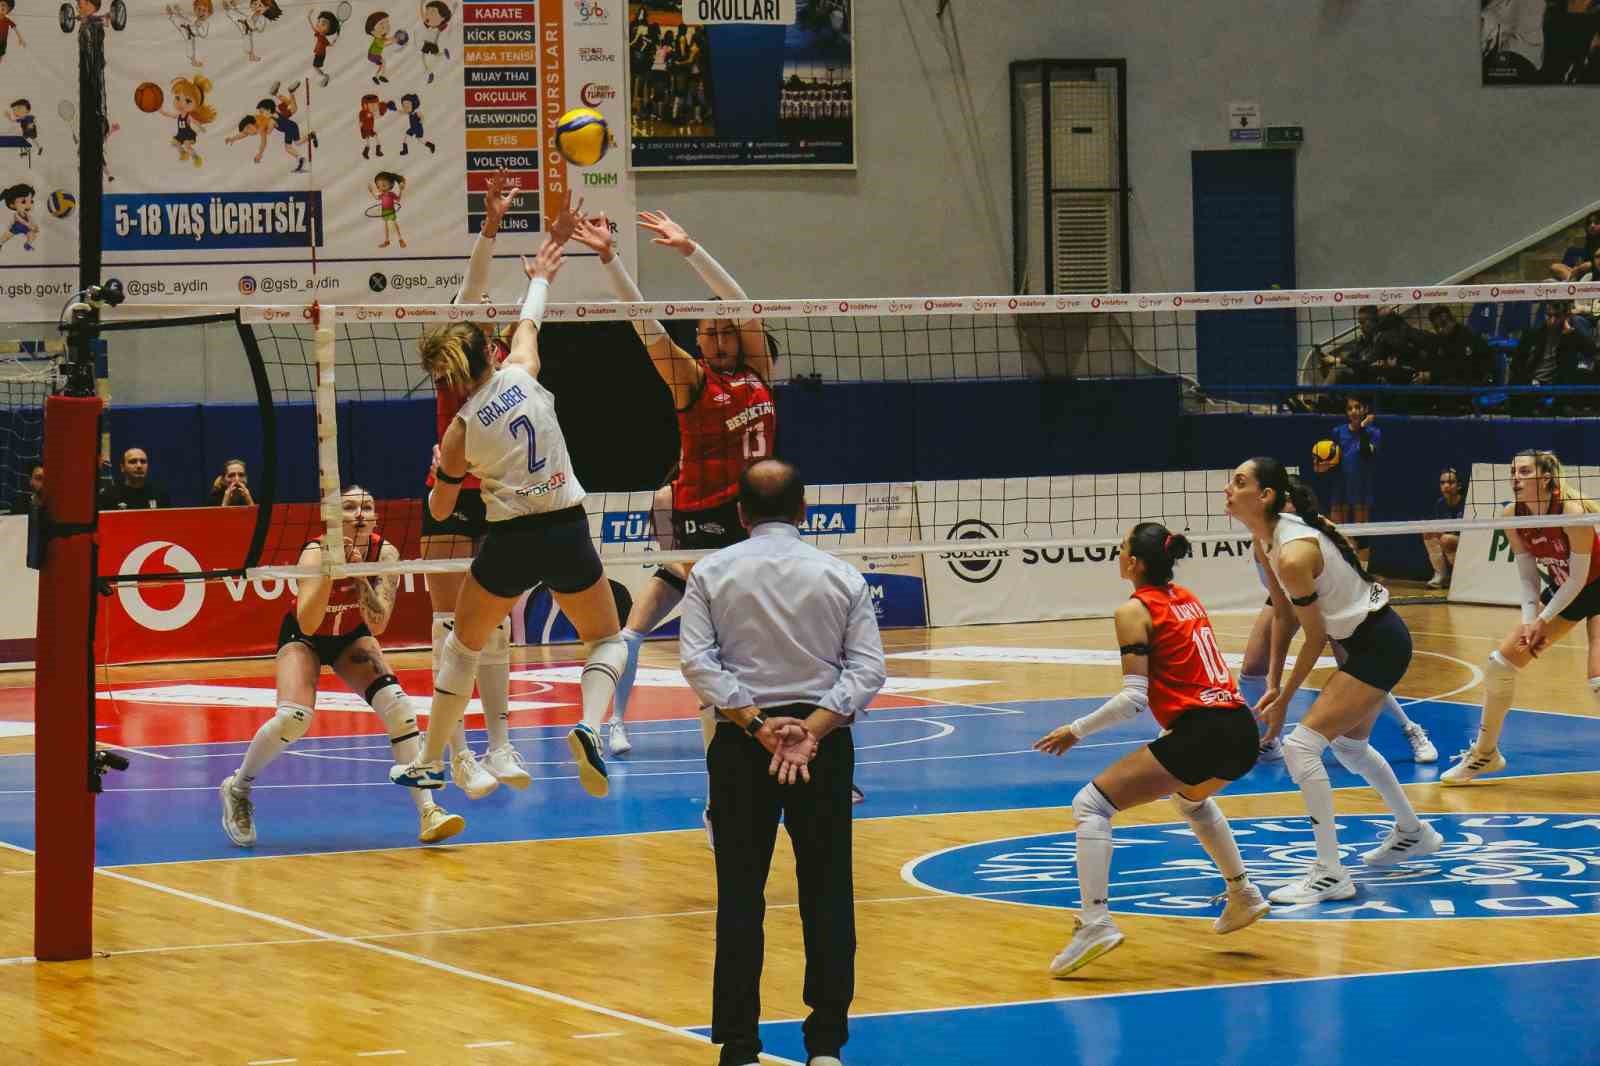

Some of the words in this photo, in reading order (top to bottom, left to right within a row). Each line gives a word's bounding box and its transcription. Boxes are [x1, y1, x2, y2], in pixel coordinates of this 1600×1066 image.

[475, 8, 523, 19] KARATE
[466, 28, 495, 41] KİCK
[498, 29, 532, 41] BOKS
[465, 52, 497, 63] MASA
[471, 71, 501, 82] MUAY
[504, 71, 529, 81] THAI
[545, 22, 561, 128] KURSLARI
[474, 91, 528, 104] OKÇULUK
[466, 112, 537, 124] TAEKWONDO
[473, 156, 532, 167] VOLEYBOL
[485, 177, 522, 187] YME
[115, 204, 162, 237] 5-18
[166, 202, 206, 242] YAŞ
[209, 196, 307, 235] ÜCRETSİZ
[127, 278, 209, 297] @gsb_aydin
[477, 384, 528, 427] GRAJBER
[509, 414, 547, 474] 2
[742, 421, 768, 460] 13
[1022, 544, 1121, 564] SOLGA
[1192, 625, 1230, 685] 10
